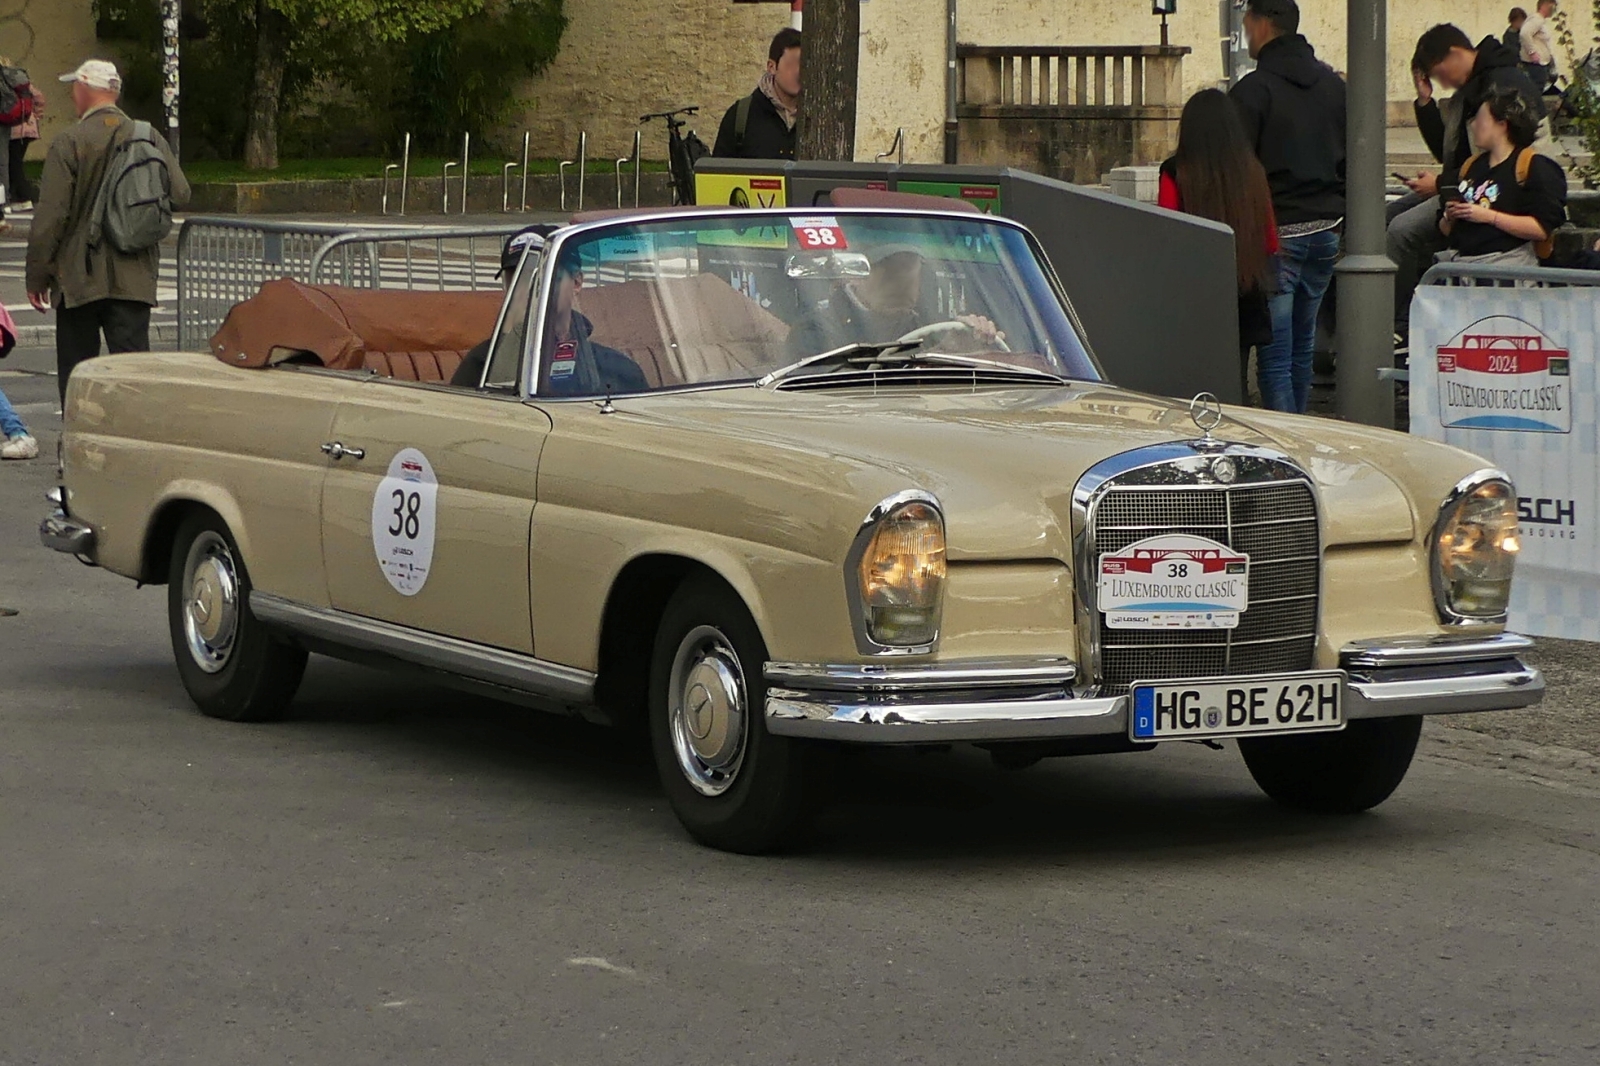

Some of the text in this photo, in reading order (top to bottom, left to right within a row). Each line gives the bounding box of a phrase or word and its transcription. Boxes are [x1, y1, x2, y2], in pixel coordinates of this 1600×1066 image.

[803, 228, 837, 245] 38
[1488, 355, 1518, 372] 2024
[1446, 380, 1563, 412] LUXEMBOURG CLASSIC
[388, 489, 421, 540] 38
[1517, 497, 1575, 526] SCH
[1167, 563, 1188, 578] 38
[1111, 578, 1238, 599] LUXEMBOURG CLASSIC
[1139, 682, 1338, 730] D HG BE 62H
